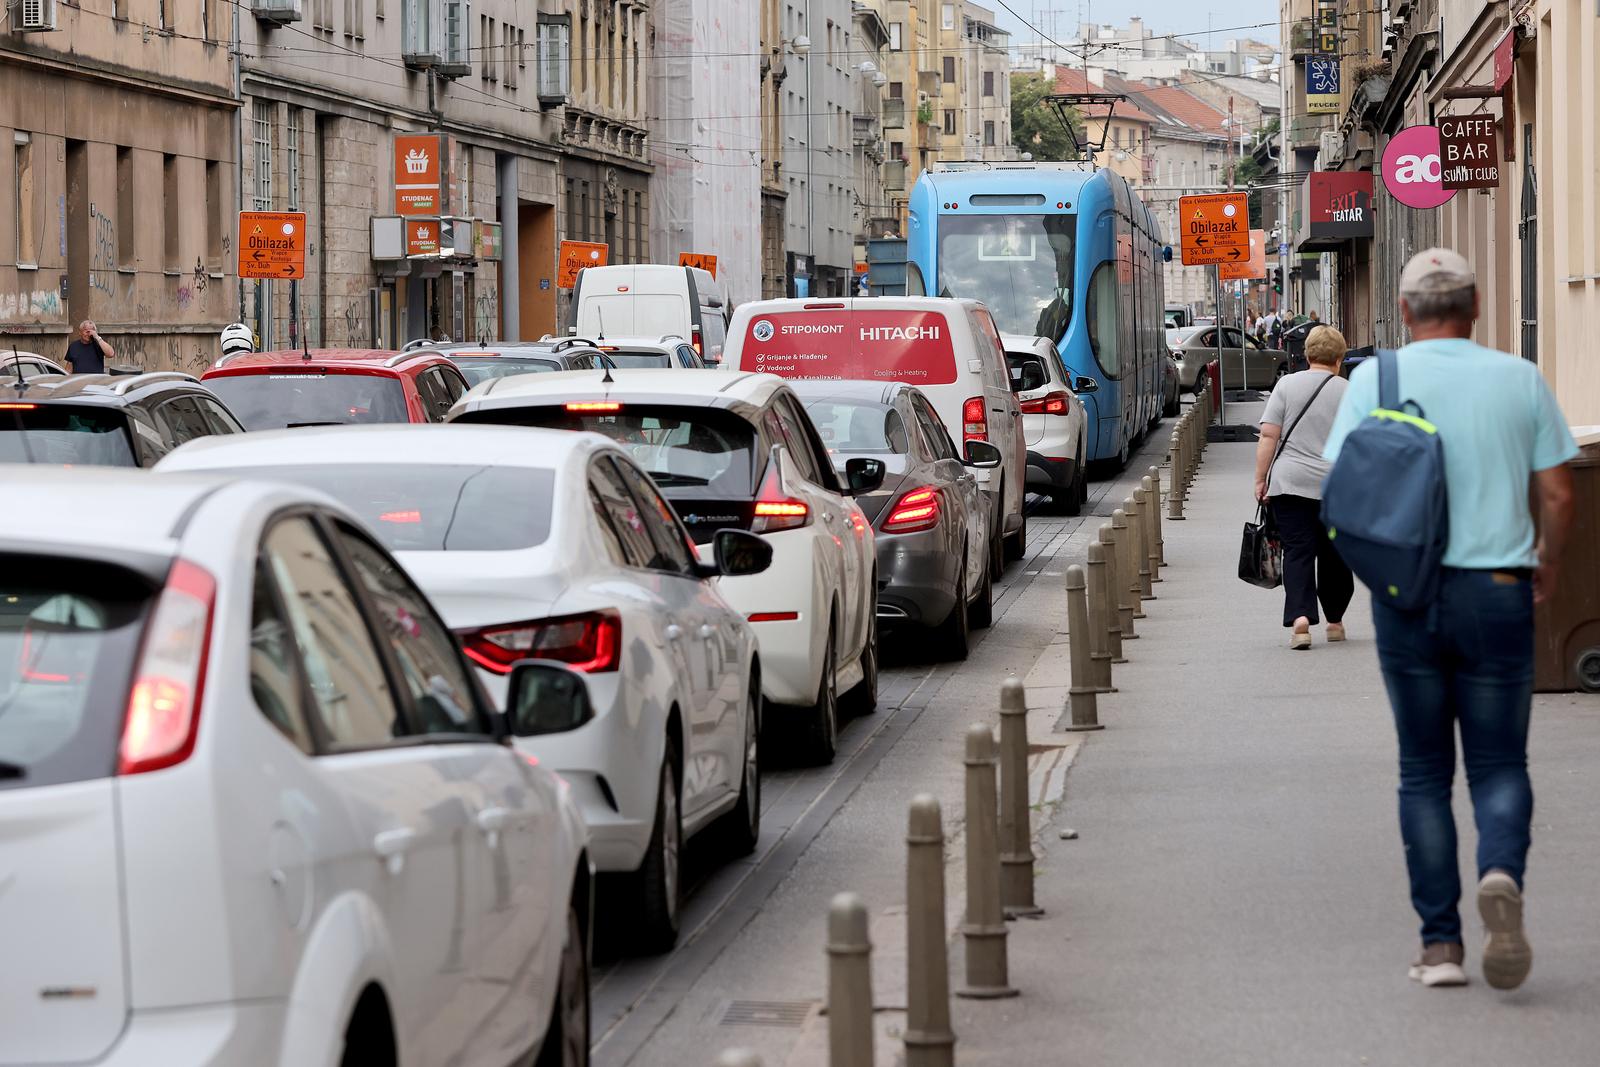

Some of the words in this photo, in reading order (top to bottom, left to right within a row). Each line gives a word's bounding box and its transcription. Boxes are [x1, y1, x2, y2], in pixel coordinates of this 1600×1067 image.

[1441, 119, 1493, 138] CAFFE
[1447, 143, 1489, 161] BAR
[1475, 166, 1498, 181] CLUB
[1331, 190, 1358, 211] EXIT
[1332, 207, 1363, 222] TEATAR
[1190, 219, 1238, 234] Obilazak
[249, 236, 295, 249] Obilazak
[1190, 248, 1200, 256] Sv.
[781, 324, 844, 335] STIPOMONT
[859, 326, 939, 341] HITACHI
[766, 354, 792, 362] Grijanje
[873, 369, 897, 378] Cooling
[903, 369, 928, 378] Heating
